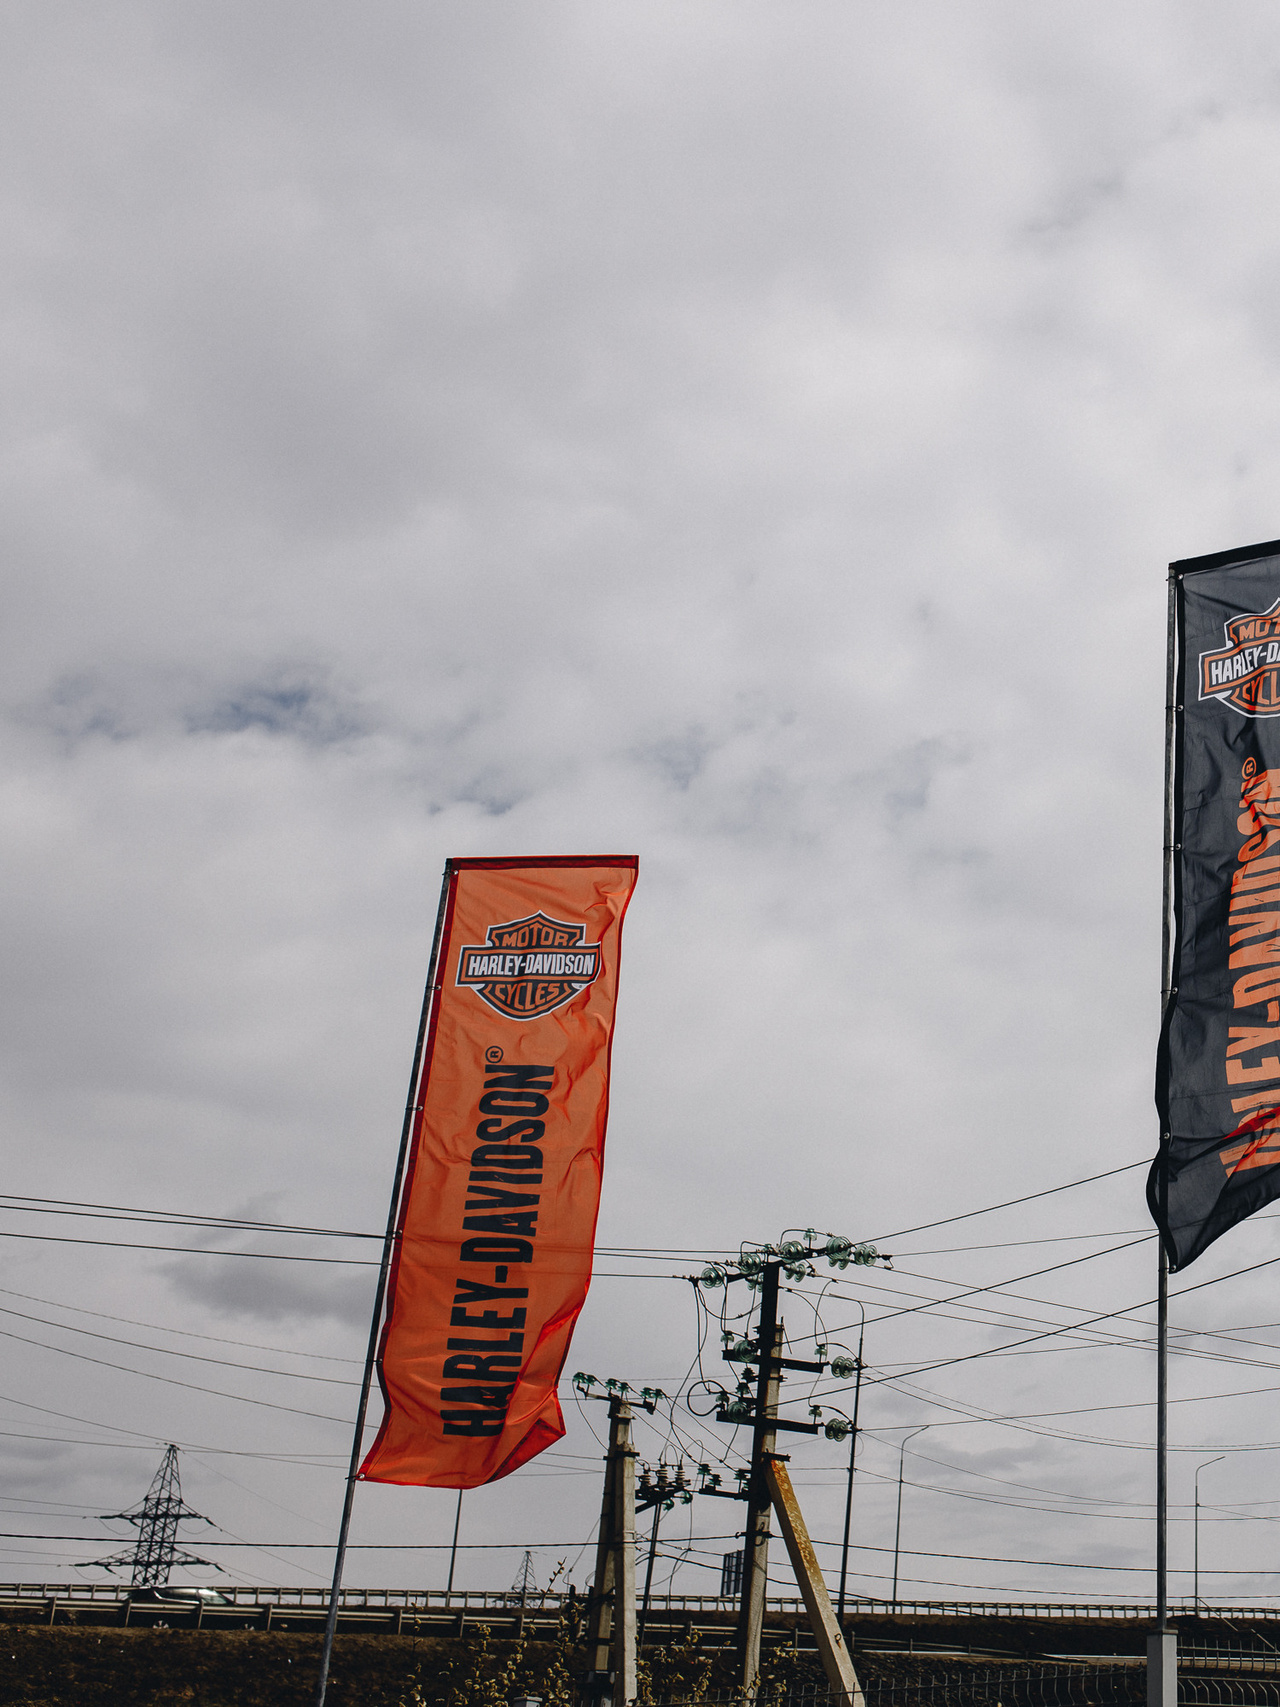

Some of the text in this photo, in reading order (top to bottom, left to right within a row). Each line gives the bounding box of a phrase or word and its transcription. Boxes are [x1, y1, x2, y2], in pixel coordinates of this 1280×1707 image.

[502, 922, 569, 947] MOTOR
[468, 953, 595, 976] HARLEY-DAVIDSON
[495, 982, 561, 1011] CYCLES
